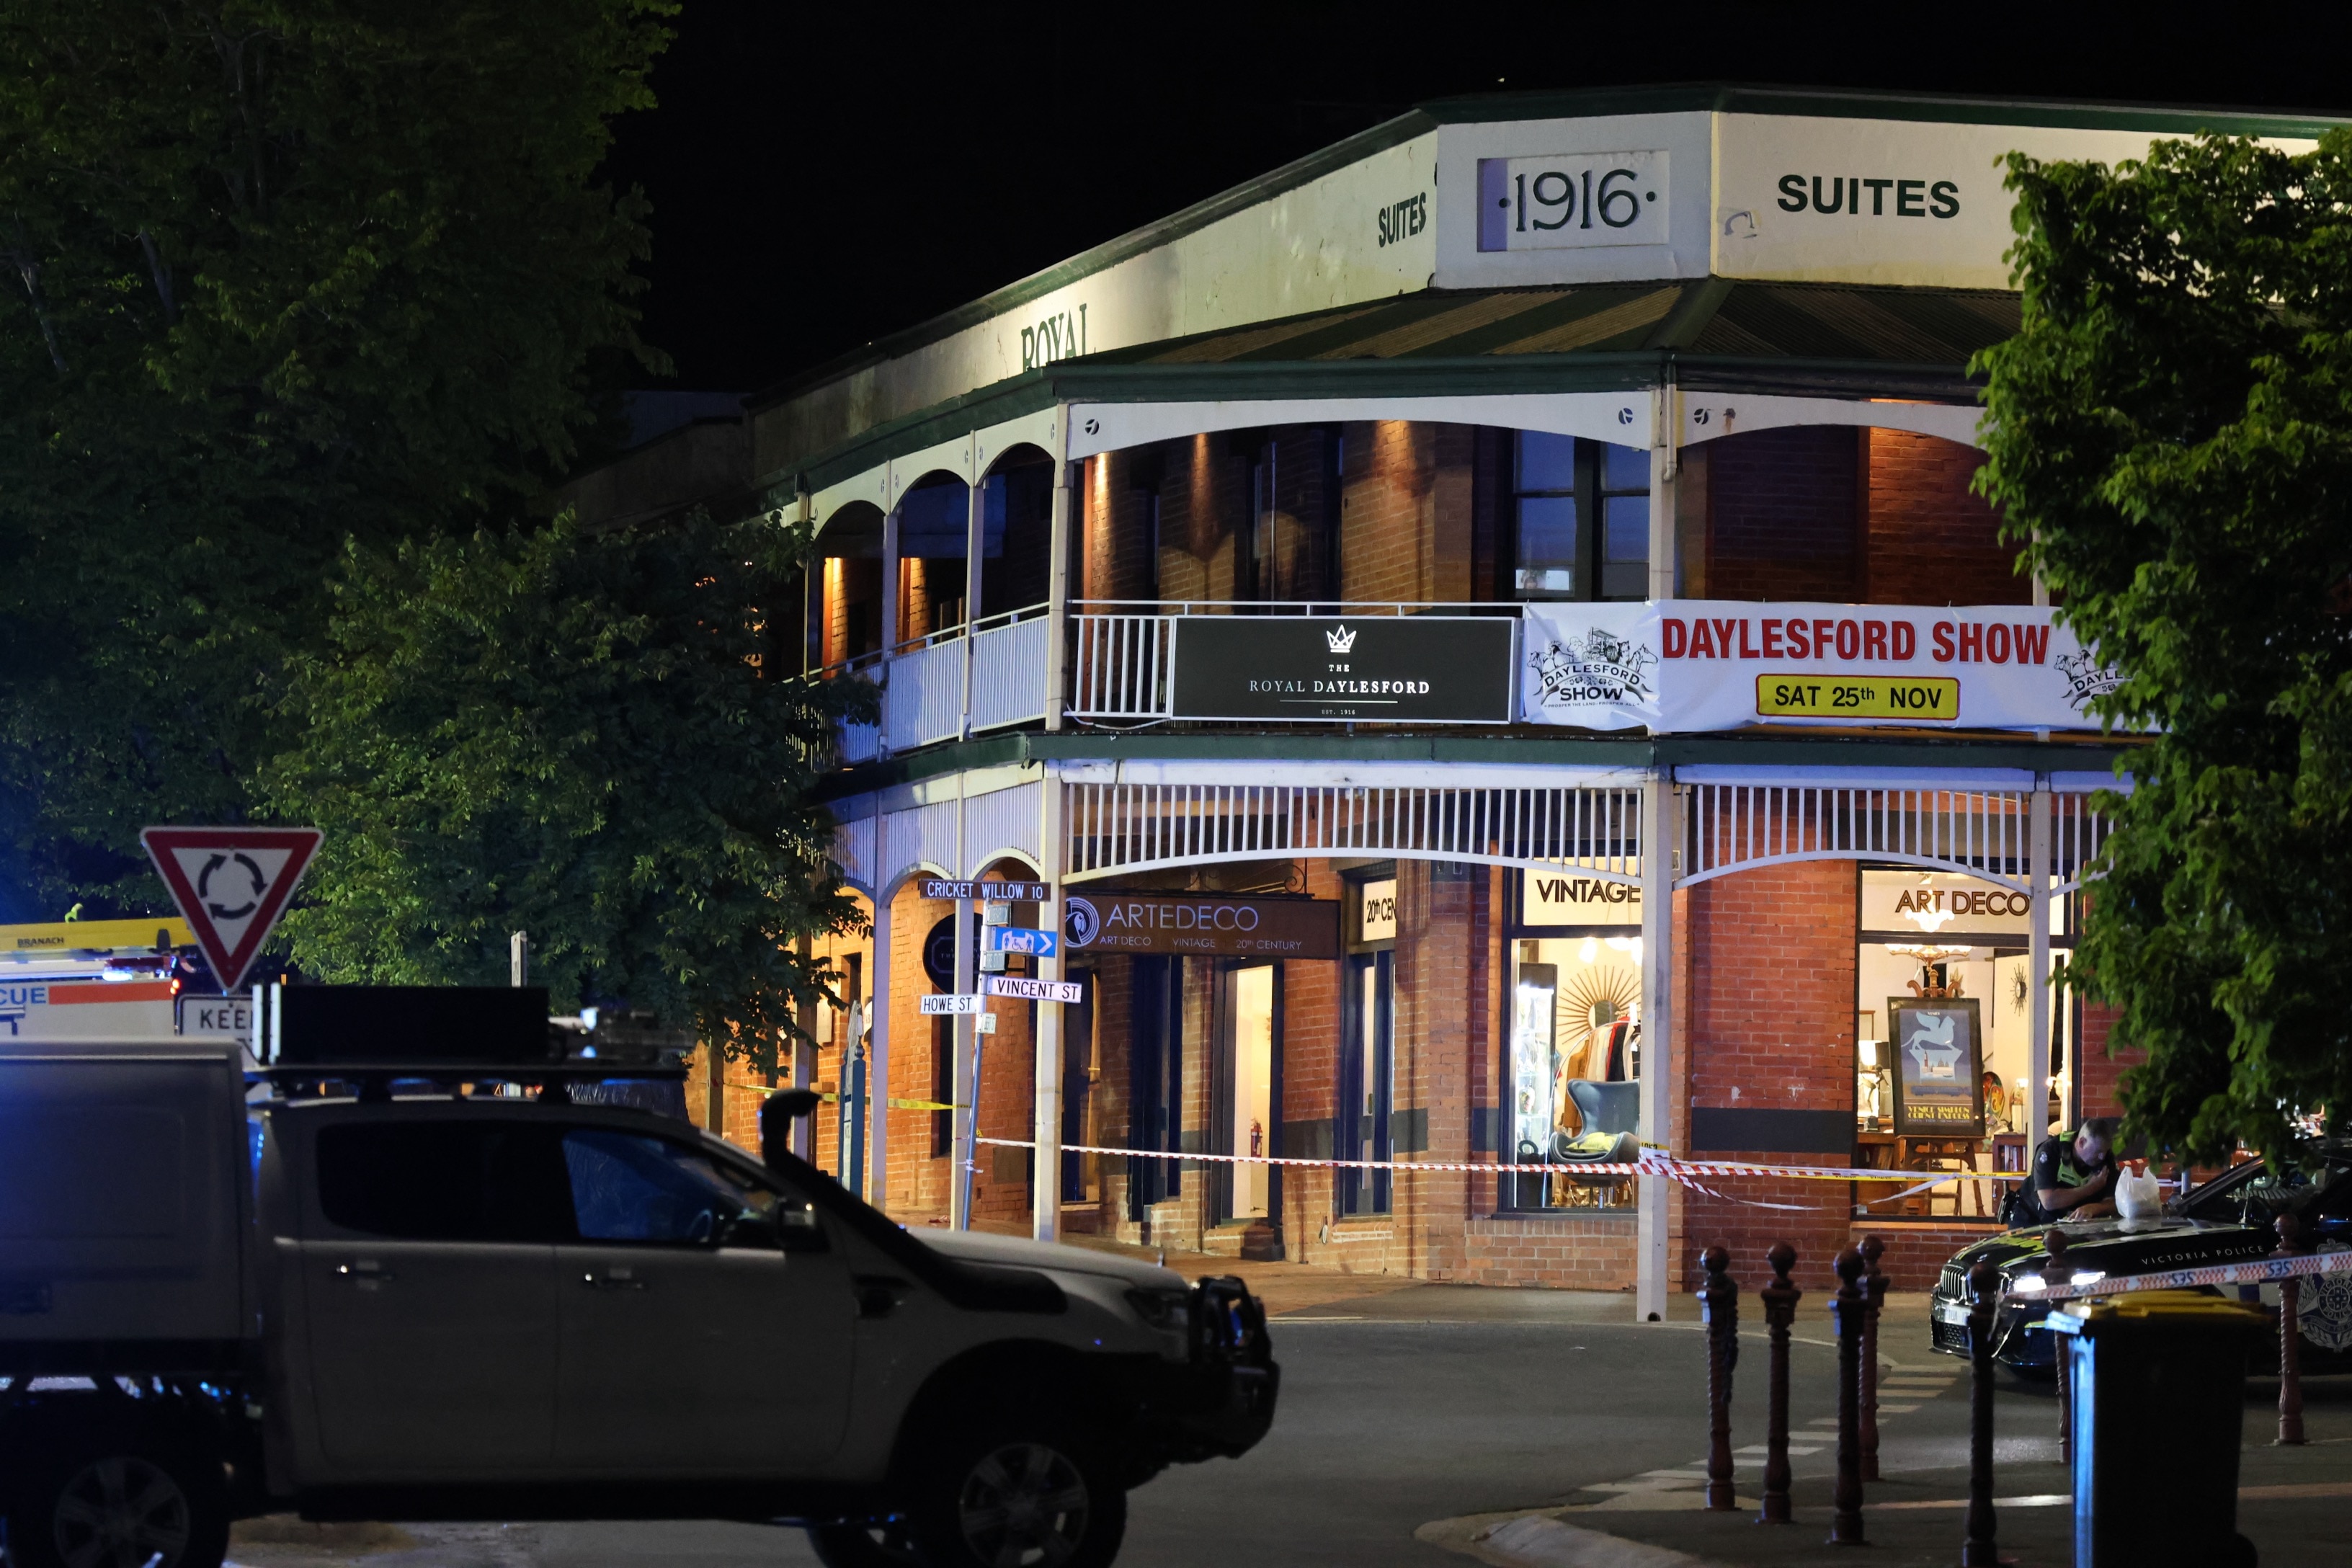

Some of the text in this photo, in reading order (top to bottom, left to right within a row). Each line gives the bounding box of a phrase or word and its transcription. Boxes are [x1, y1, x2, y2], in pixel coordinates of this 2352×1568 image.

[1515, 169, 1639, 232] 1916
[1777, 174, 1960, 218] SUITES
[1378, 192, 1426, 248] SUITES
[1662, 618, 2050, 665] DAYLESFORD SHOW
[1544, 664, 1640, 687] DAYLESFORD
[1250, 680, 1430, 694] ROYAL DAYLESFORD
[1560, 687, 1623, 701] SHOW
[1775, 685, 1942, 709] SAT 25th NOV
[927, 881, 1043, 899] CRICKET WILLOW 10
[1536, 879, 1641, 903] VINTAGE
[1895, 889, 2030, 916] ART DECO
[1106, 903, 1259, 932] ARTEDECO
[17, 937, 64, 948] BRANACH
[1100, 936, 1302, 950] ART DECO VINTAGE 20th CENTURY
[997, 979, 1078, 999] VINCENT ST
[924, 997, 972, 1012] HOWE ST
[200, 1009, 252, 1030] KEE
[2141, 1245, 2264, 1265] VICTORIA POLICE
